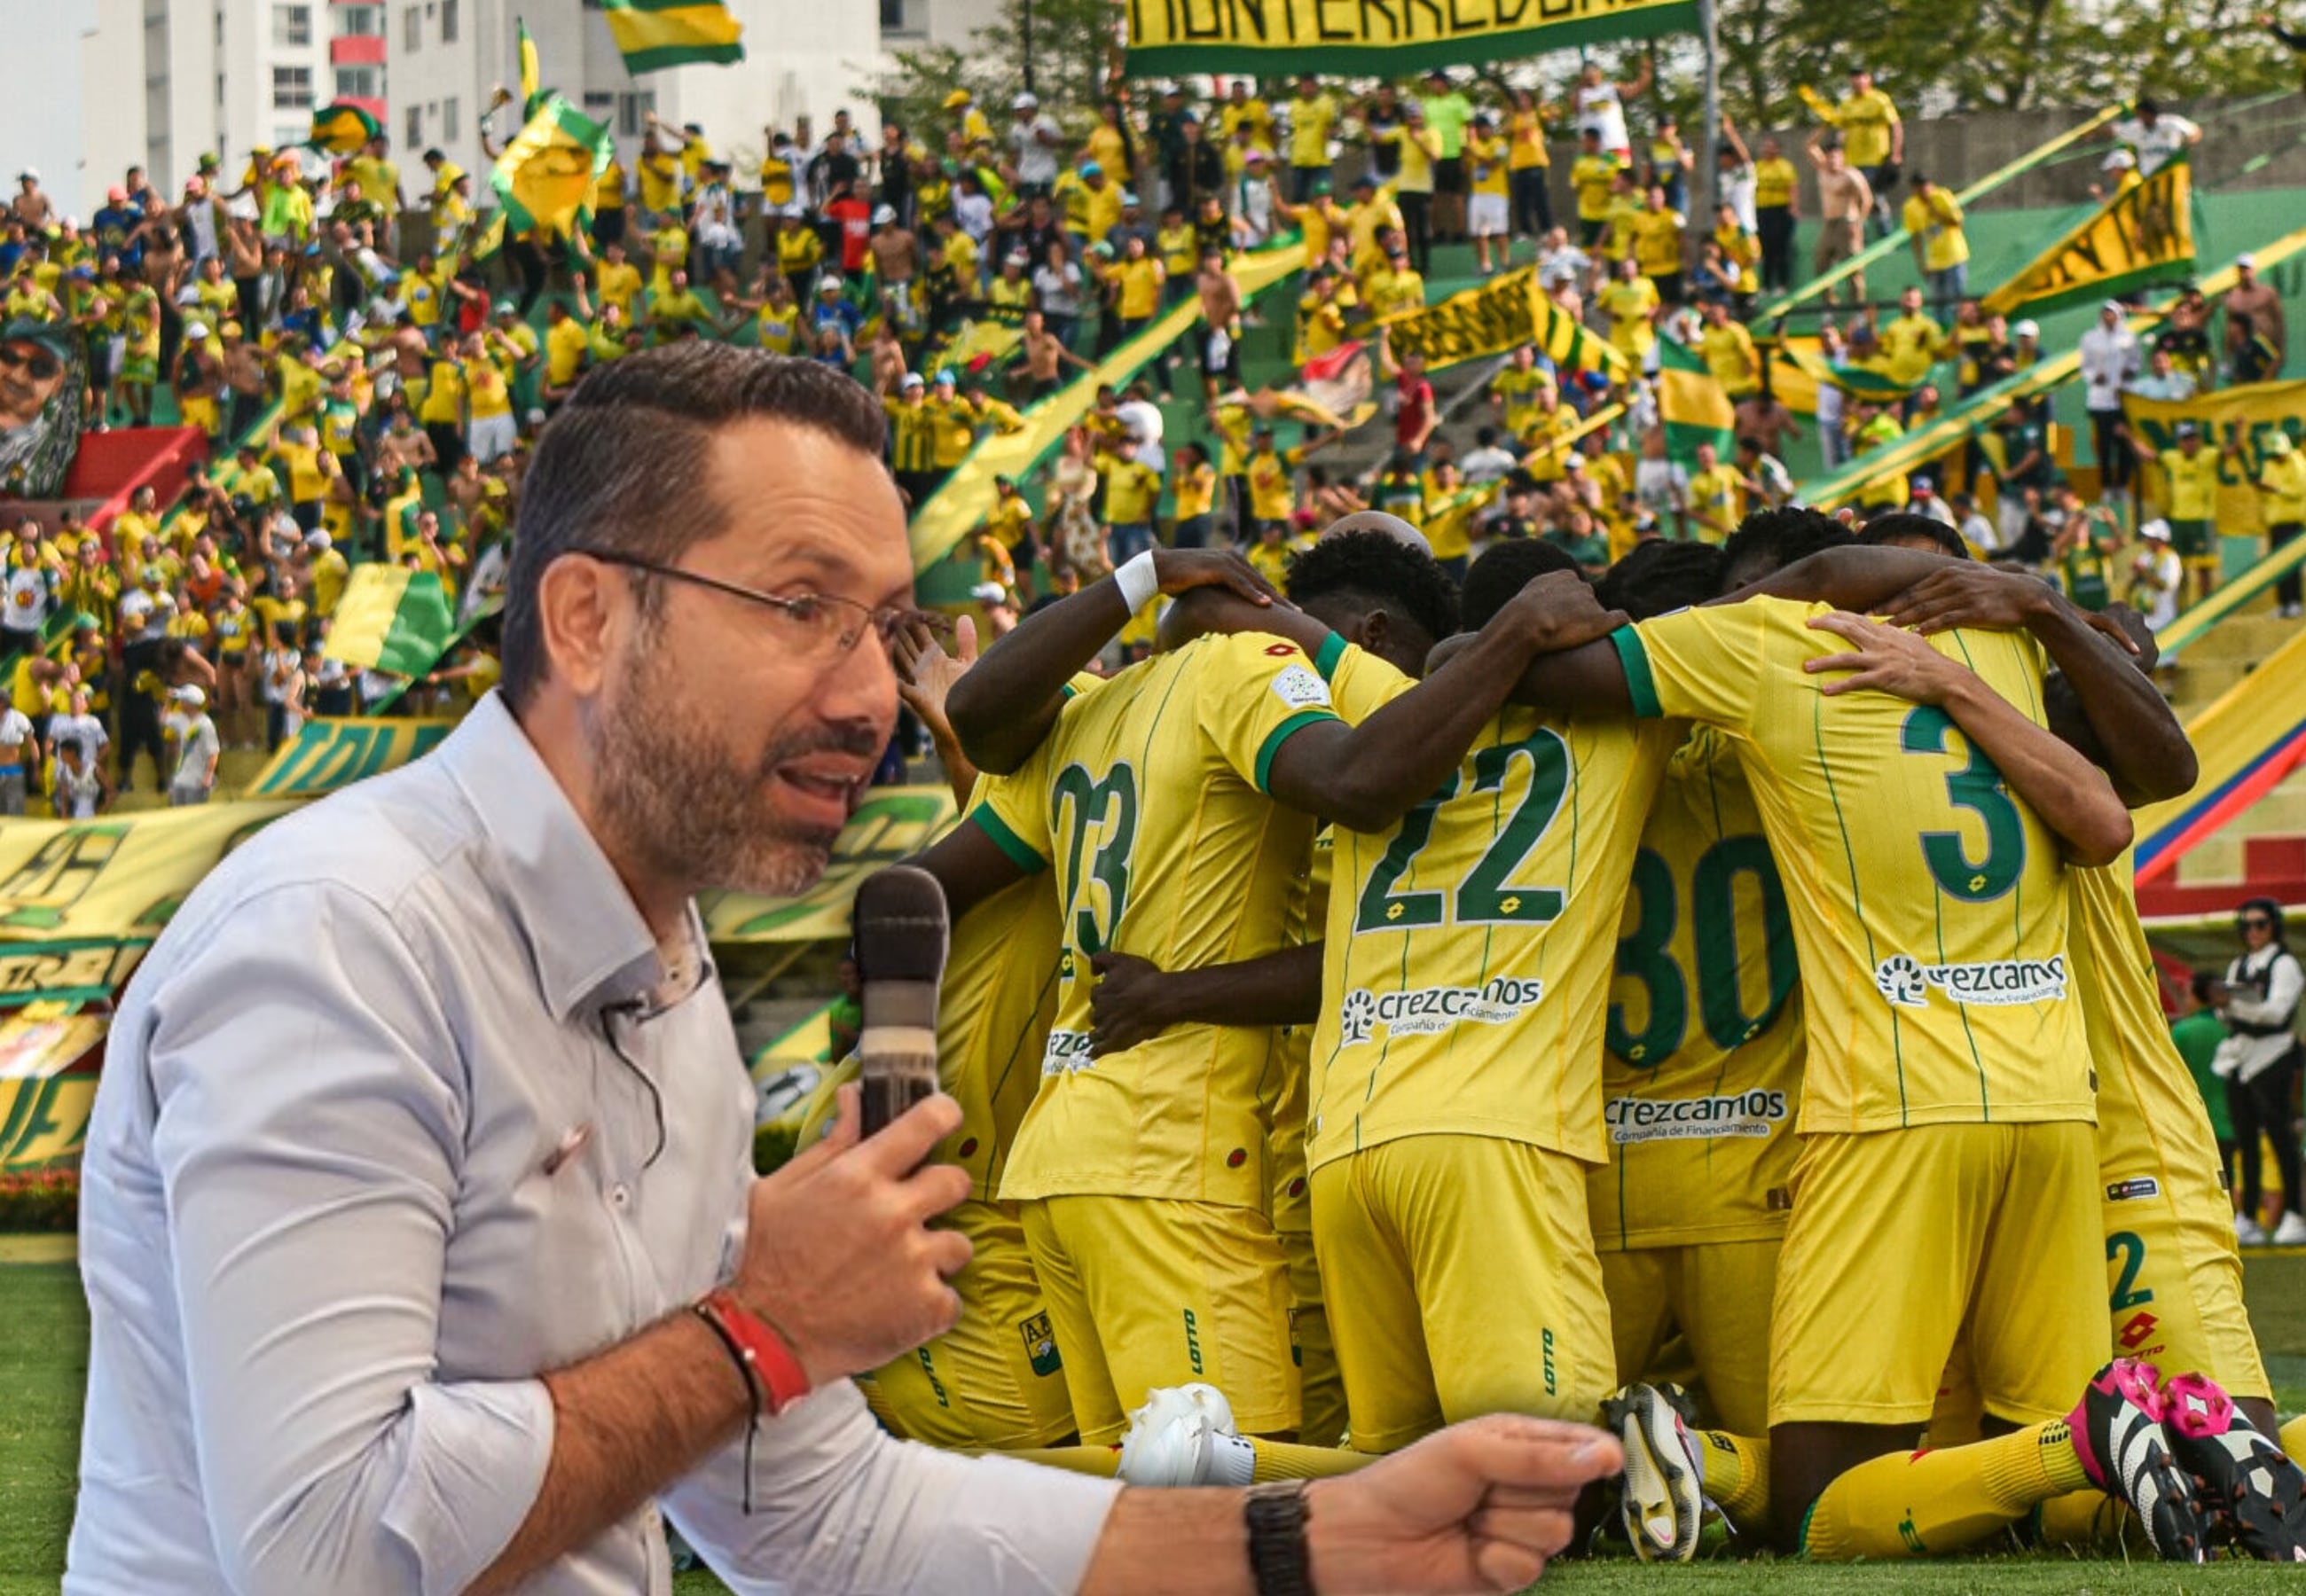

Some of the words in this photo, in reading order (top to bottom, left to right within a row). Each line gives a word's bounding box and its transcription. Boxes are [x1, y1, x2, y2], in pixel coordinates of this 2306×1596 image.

[1353, 725, 1568, 936] 22
[1900, 703, 2027, 903] 3
[1609, 833, 1800, 1070] 30
[1605, 1091, 1784, 1126] crezcamos
[1615, 1127, 1668, 1142] Compañía
[1669, 1124, 1684, 1137] de
[1686, 1122, 1769, 1135] Financiamiento
[2106, 1231, 2153, 1311] 2
[1183, 1309, 1204, 1375] LOTTO
[1542, 1327, 1556, 1396] LOTTO
